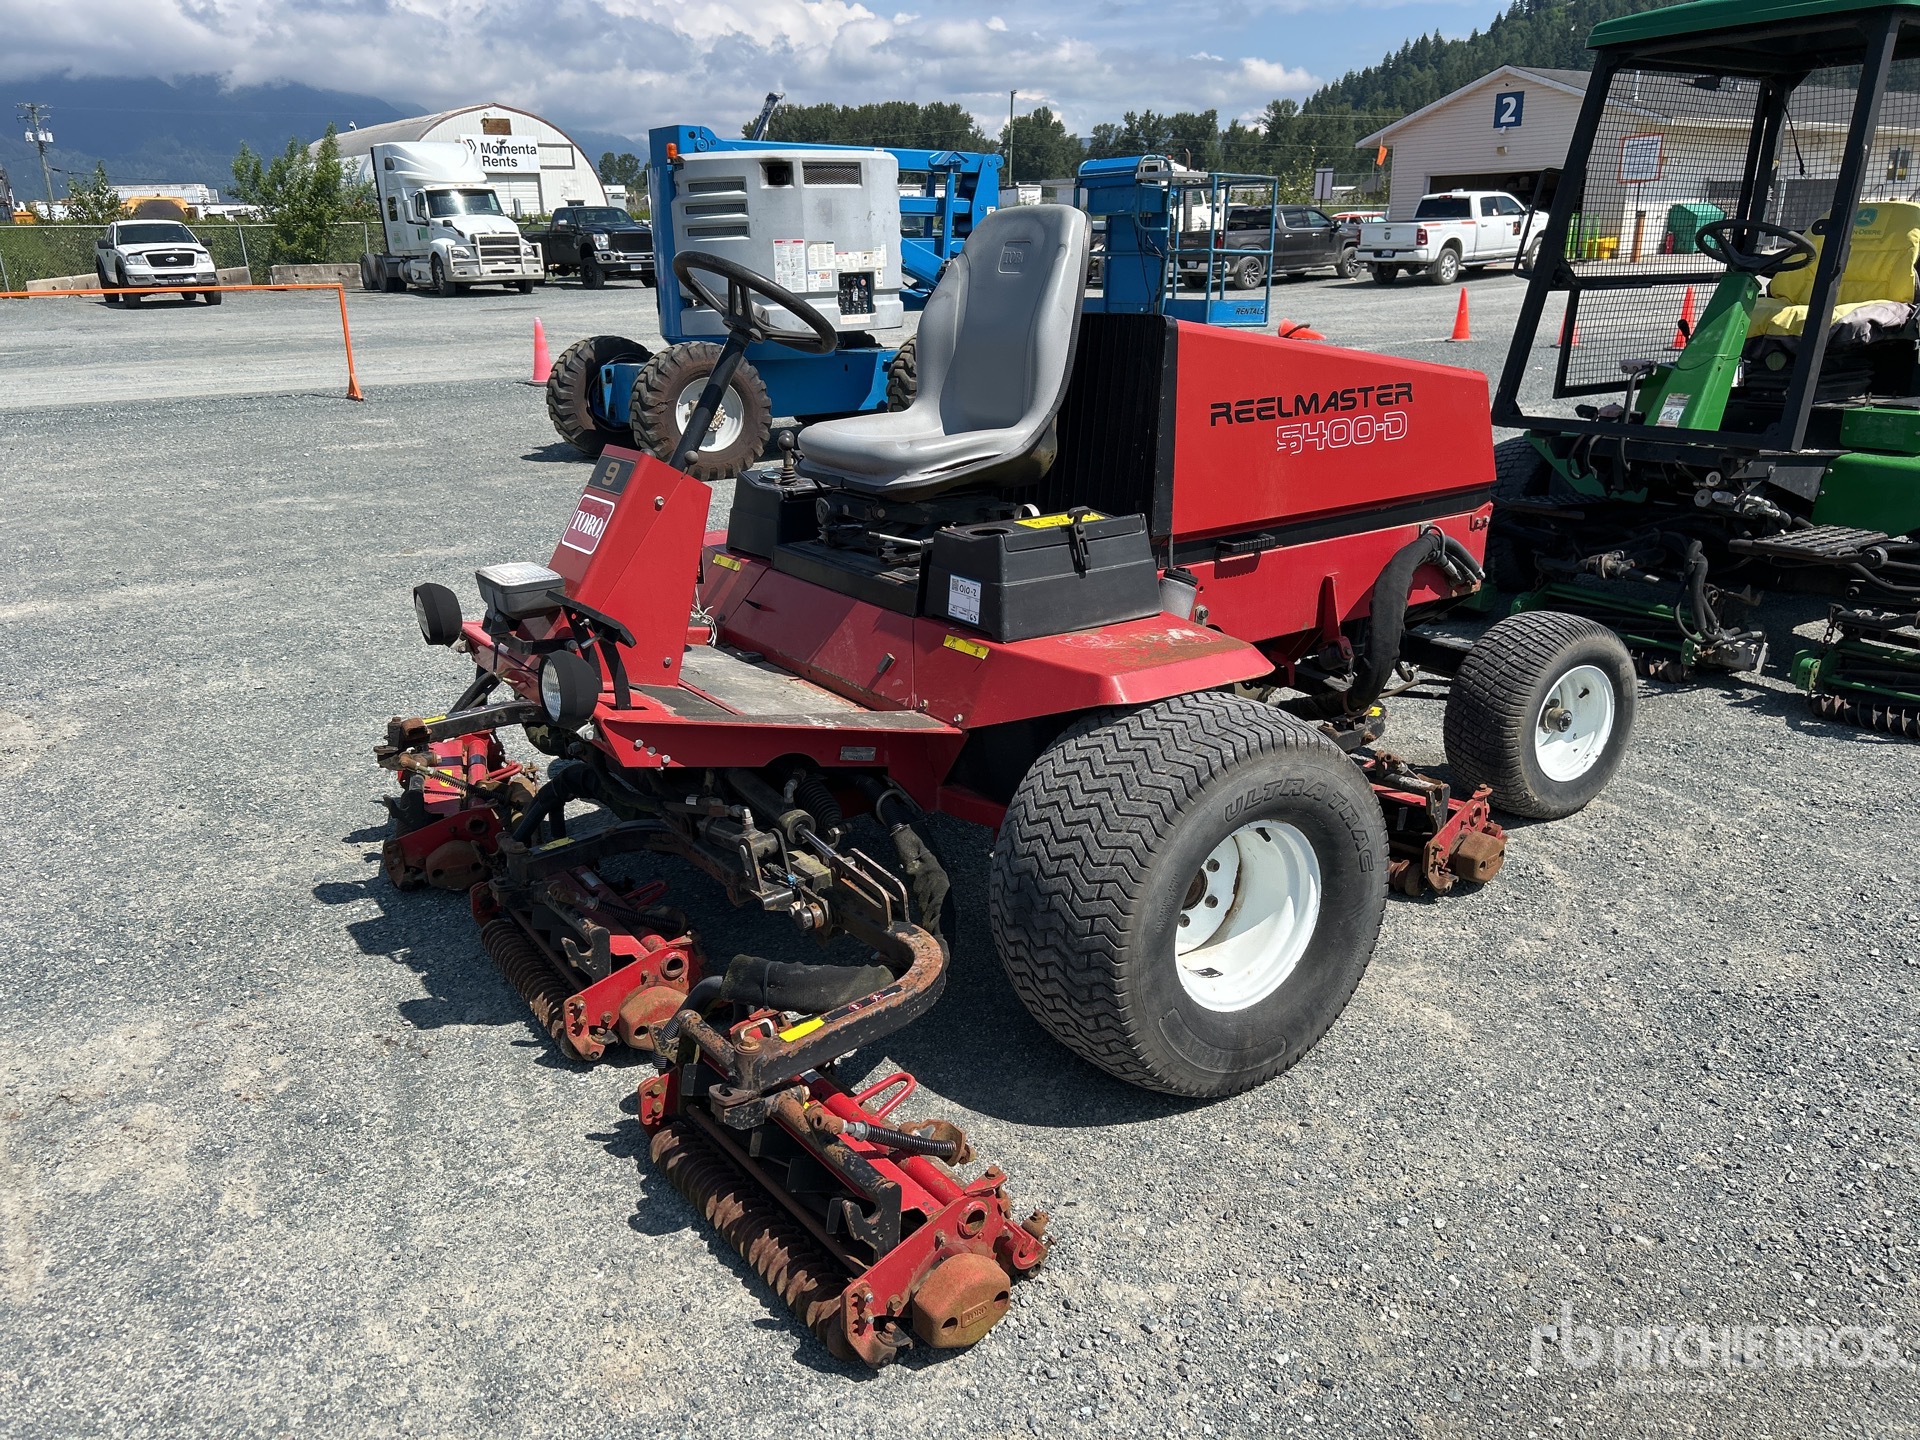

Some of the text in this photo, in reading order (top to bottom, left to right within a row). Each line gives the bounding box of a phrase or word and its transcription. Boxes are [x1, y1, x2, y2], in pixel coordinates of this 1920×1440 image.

[1500, 96, 1516, 123] 2
[480, 142, 537, 155] Momenta
[482, 155, 518, 167] Rents
[1235, 307, 1265, 315] RENTALS
[1210, 382, 1413, 427] REELMASTER
[1276, 410, 1408, 457] 5400-D
[601, 461, 621, 486] 9
[1224, 778, 1375, 873] ULTRA TRAC
